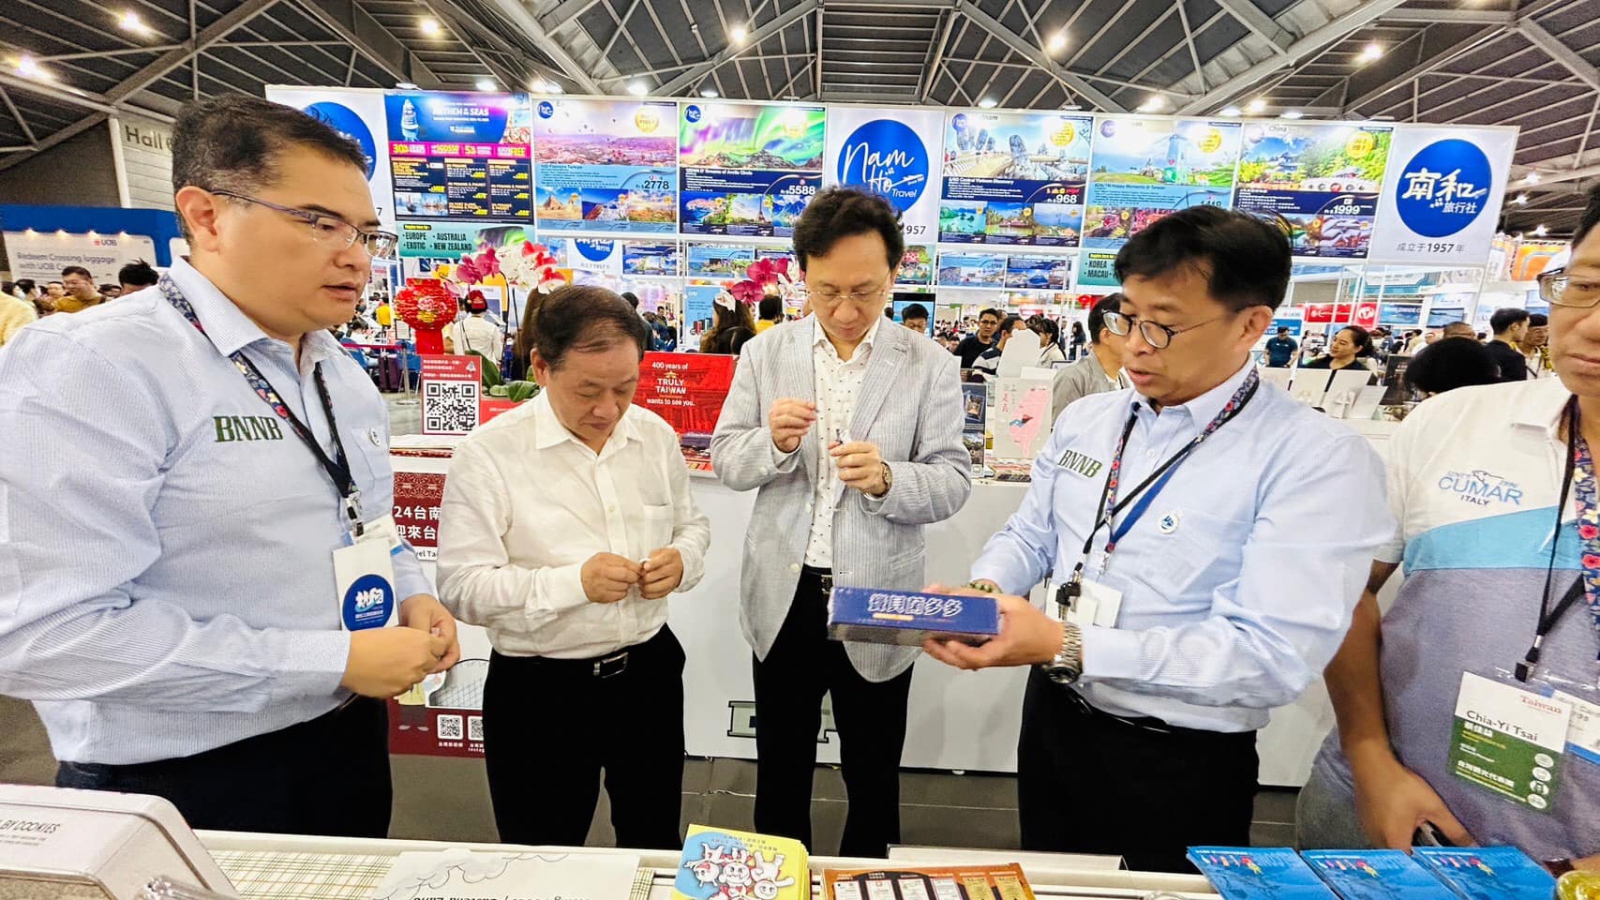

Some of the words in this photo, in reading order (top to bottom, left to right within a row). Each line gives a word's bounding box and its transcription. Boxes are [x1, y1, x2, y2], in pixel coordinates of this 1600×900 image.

[125, 125, 162, 150] Hall
[842, 141, 915, 184] Nam
[868, 164, 893, 193] Ho
[1402, 167, 1487, 200] 南和
[892, 188, 918, 198] Travel
[1442, 201, 1478, 214] 旅行社
[905, 225, 927, 235] 957
[405, 232, 427, 240] EUROPE
[436, 233, 467, 241] AUSTRALIA
[406, 242, 426, 250] EXOTIC
[433, 242, 446, 251] NEW
[447, 242, 472, 251] ZEALAND
[1426, 243, 1455, 253] 1957
[1088, 260, 1107, 268] KOREA
[1087, 269, 1109, 278] MACAU
[651, 361, 665, 369] 400
[681, 362, 689, 370] of
[657, 378, 685, 386] TRULY
[655, 385, 687, 394] TAIWAN
[213, 416, 283, 442] BNNB
[1057, 449, 1103, 478] BNNB
[1438, 475, 1524, 506] CUMAR
[1460, 494, 1490, 506] ITALY
[1520, 694, 1563, 714] Taiwan
[1466, 710, 1509, 732] Chia-Yi
[1514, 725, 1538, 742] Tsai
